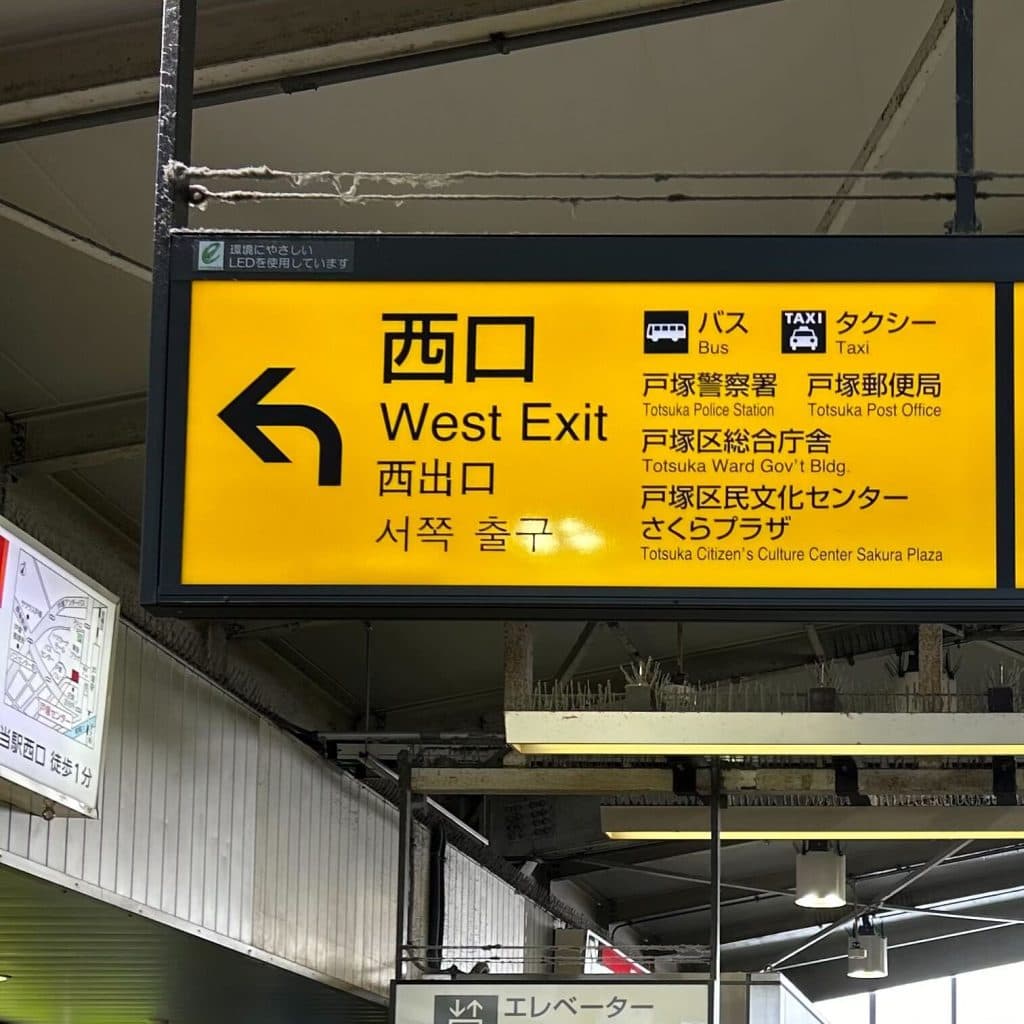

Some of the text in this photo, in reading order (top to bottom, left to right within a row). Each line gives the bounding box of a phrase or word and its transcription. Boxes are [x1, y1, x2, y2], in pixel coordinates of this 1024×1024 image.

[230, 244, 313, 256] 環境にやさしい
[229, 257, 349, 270] LEDを使用しています
[697, 311, 749, 334] バス
[784, 312, 822, 324] TAXI
[836, 311, 937, 334] タクシー
[381, 313, 536, 384] 西口
[698, 341, 729, 355] Bus
[836, 341, 869, 355] Taxi
[643, 372, 777, 398] 戸塚警察署
[807, 372, 942, 398] 戸塚郵便局
[381, 402, 608, 442] West Exit
[643, 403, 774, 418] Totsuka Police Station
[808, 403, 942, 418] Totsuka Post Office
[642, 428, 831, 454] 戸塚区総合庁舎
[377, 459, 496, 497] 西出口
[642, 459, 706, 473] Totsuka
[712, 459, 755, 473] Ward
[810, 459, 850, 476] Bldg.
[641, 485, 909, 510] 戸塚区民文化センター
[375, 515, 553, 552] 서쪽 출구
[641, 516, 791, 540] さくらプラザ
[641, 547, 943, 562] Totsuka Citizen's Culture Center Sakura Plaza
[51, 750, 93, 789] 徒歩1分
[504, 996, 654, 1018] エレベーター
